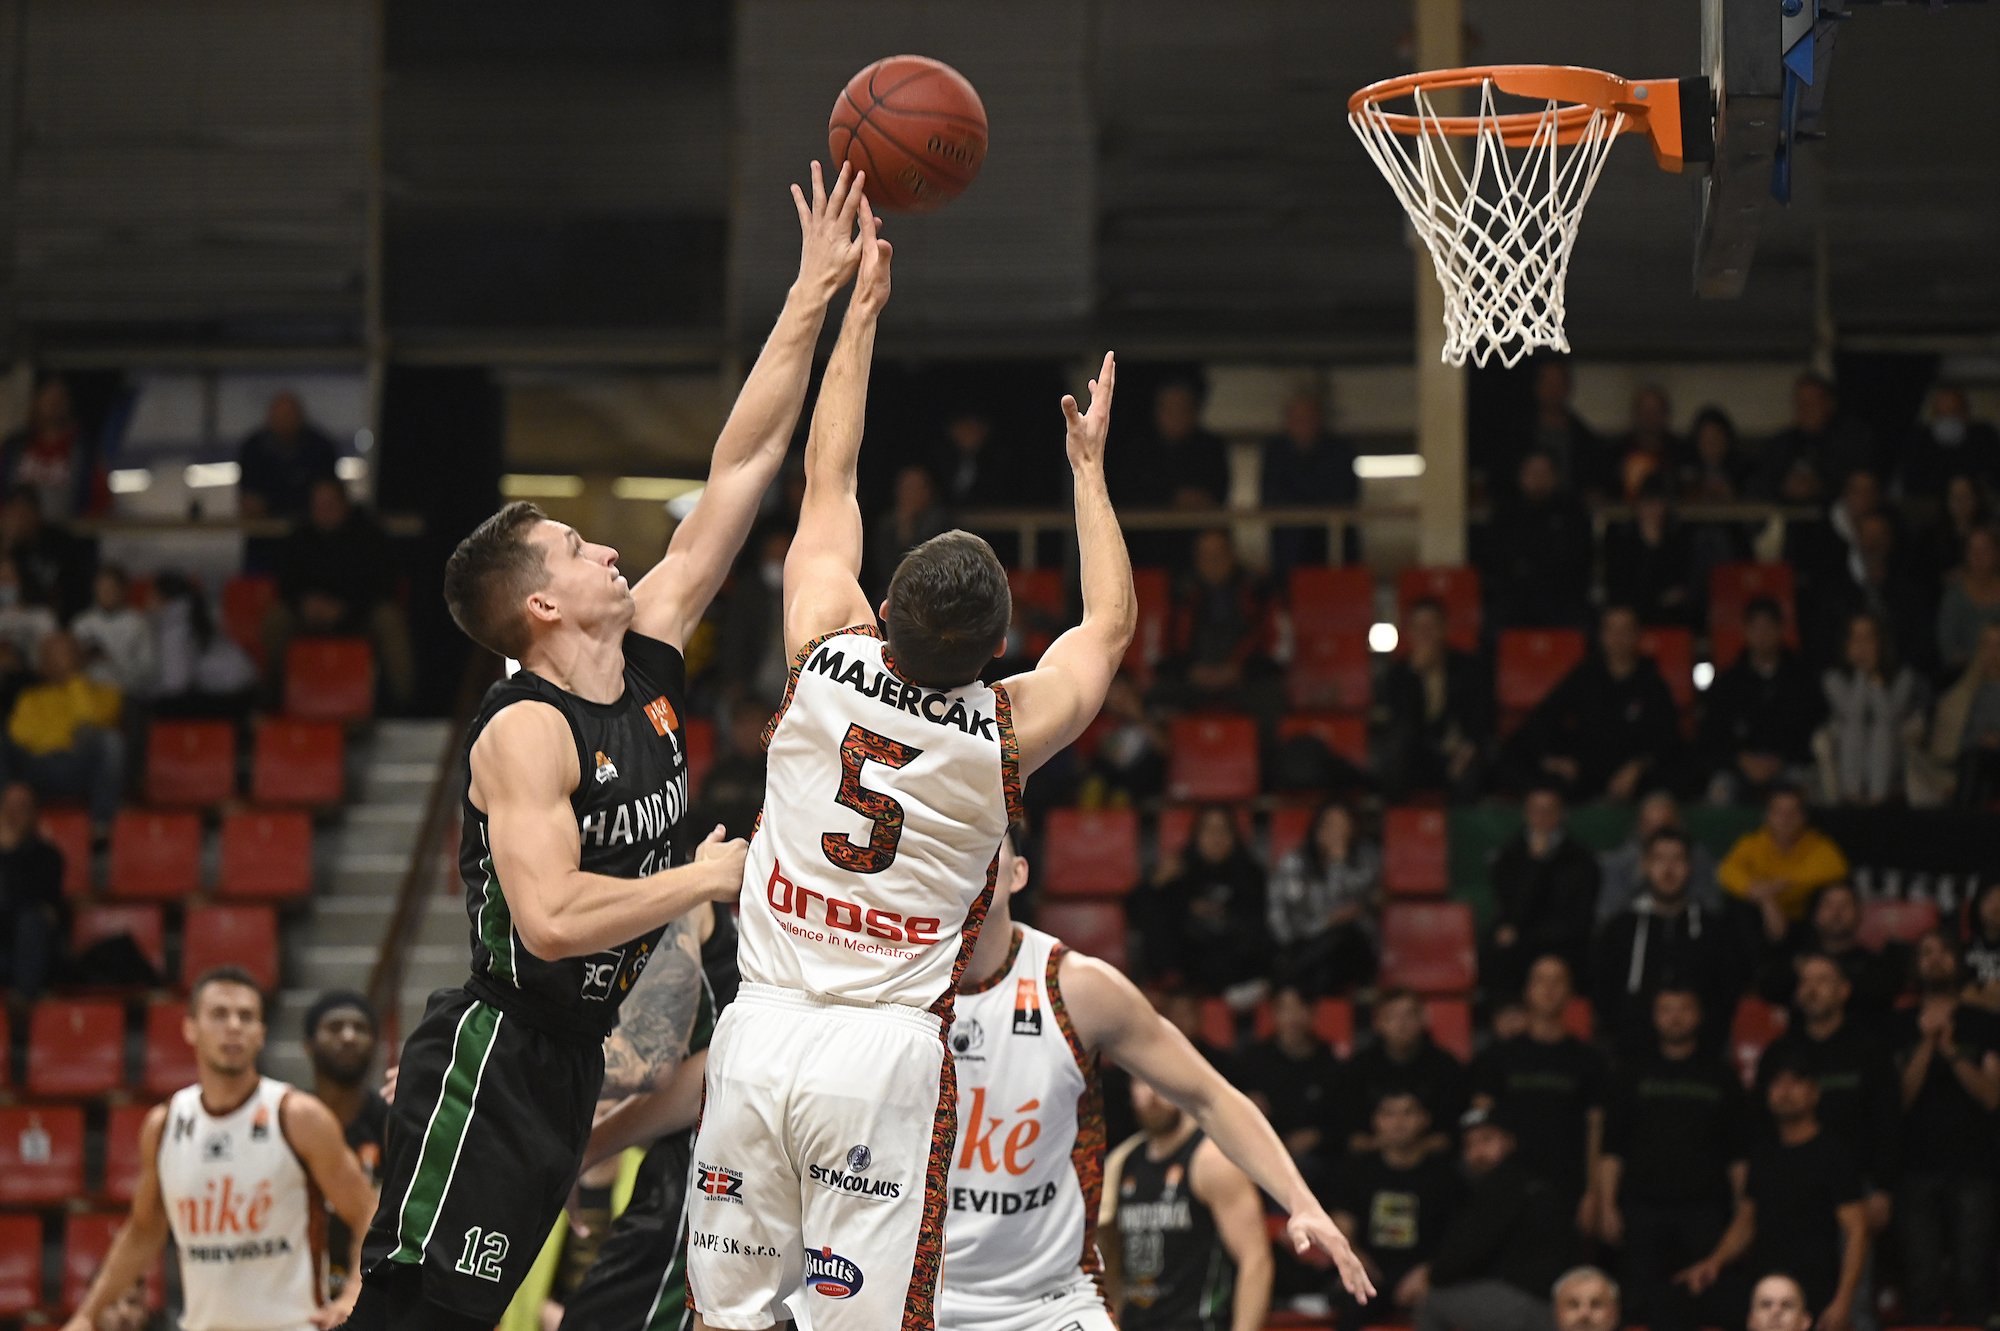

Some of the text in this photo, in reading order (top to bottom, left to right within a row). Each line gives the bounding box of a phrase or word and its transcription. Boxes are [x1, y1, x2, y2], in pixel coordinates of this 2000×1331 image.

[807, 646, 996, 742] MAJERČÁK
[821, 722, 925, 874] 5
[767, 857, 941, 945] brose
[828, 932, 840, 946] in
[958, 1087, 1041, 1176] ké
[949, 1180, 1057, 1215] EVIDZA
[455, 1226, 510, 1283] 12
[694, 1230, 781, 1258] DAPE SK s.r.o.
[805, 1250, 855, 1283] Budiš
